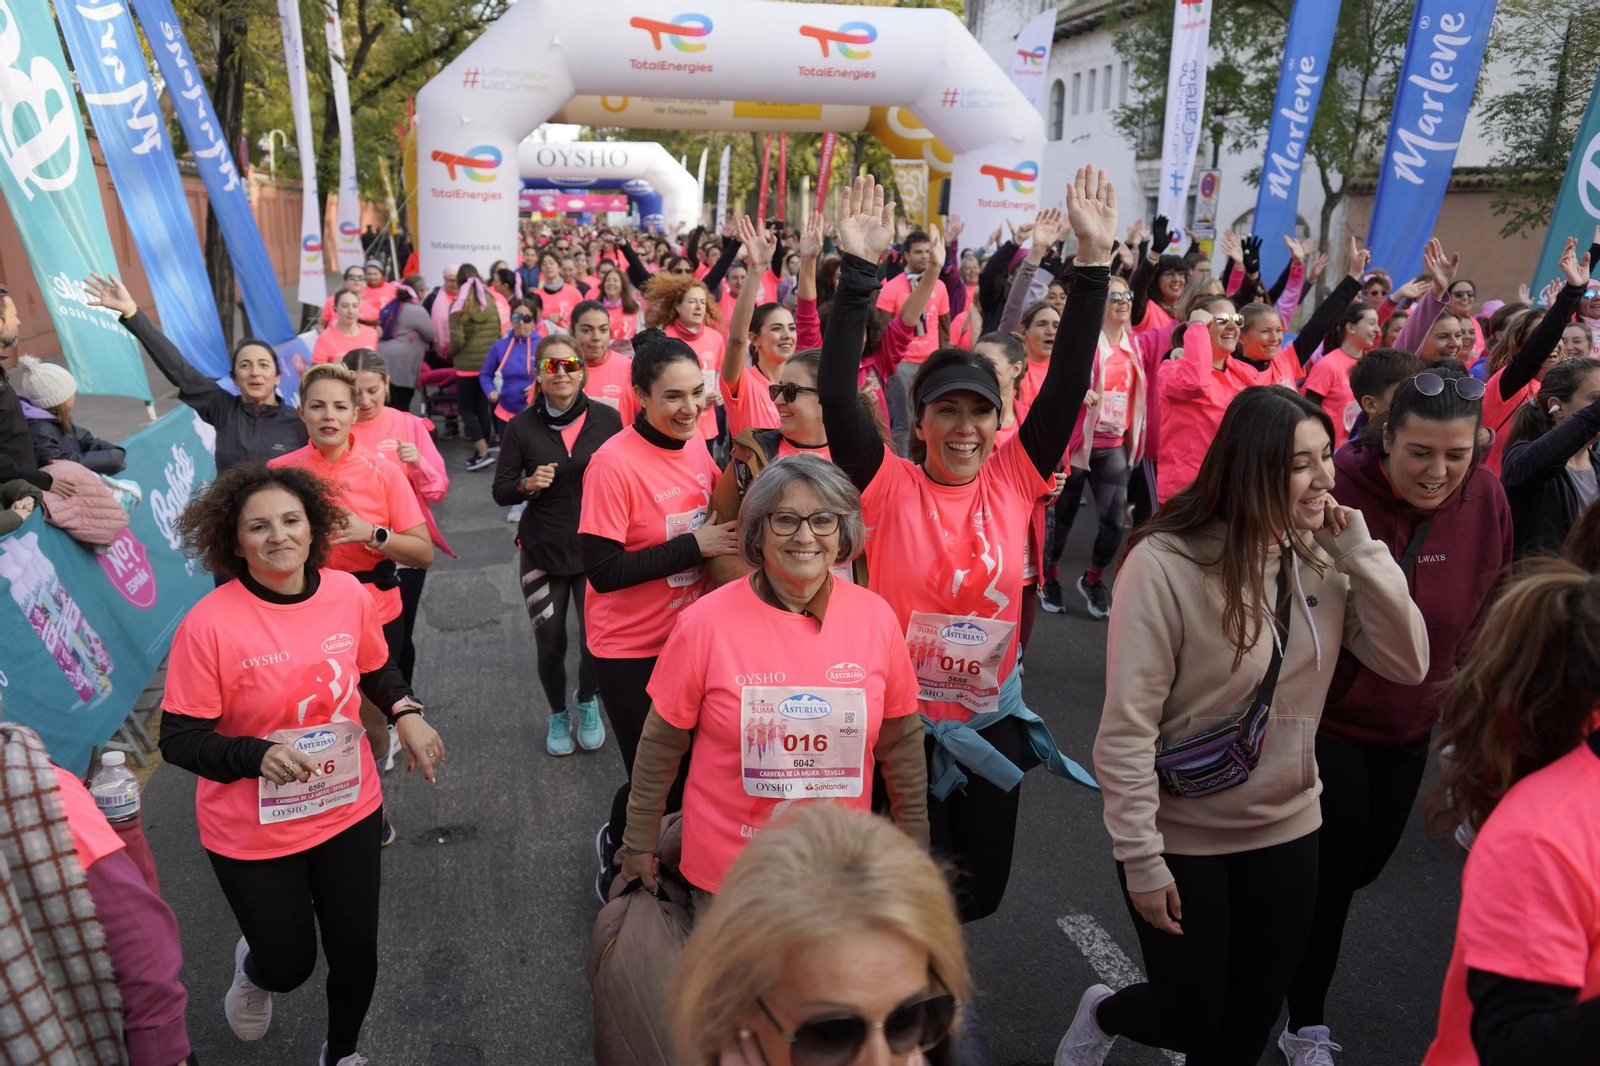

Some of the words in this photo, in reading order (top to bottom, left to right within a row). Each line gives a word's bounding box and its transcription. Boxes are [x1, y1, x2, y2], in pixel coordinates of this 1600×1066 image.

[630, 58, 714, 74] TotalEnergies
[798, 65, 877, 80] TotalEnergies
[1393, 12, 1471, 185] Marlene
[668, 107, 707, 116] Deportes
[1268, 55, 1320, 199] Marlene
[537, 148, 628, 167] OYSHO
[431, 187, 502, 202] TotalEnergies
[654, 486, 681, 503] OYSHO
[1418, 553, 1446, 563] LWAYS
[125, 568, 150, 596] ESPAÑA
[917, 626, 938, 636] SUMA
[944, 629, 984, 642] ASTURIANA
[242, 651, 290, 670] OYSHO
[940, 656, 981, 675] 016
[735, 671, 786, 687] OYSHO
[829, 671, 863, 680] ASTURIANA
[964, 694, 990, 708] Santander
[782, 704, 828, 714] ASTURIANA
[297, 737, 334, 750] ASTURIANA
[783, 734, 828, 752] 016
[793, 759, 815, 767] 6042
[760, 770, 785, 778] CARRERA
[276, 796, 300, 805] CARRERA
[332, 782, 350, 792] SEVILLA
[756, 782, 793, 792] OYSHO
[814, 783, 849, 791] Santander
[272, 805, 307, 817] OYSHO
[325, 793, 353, 805] Santander
